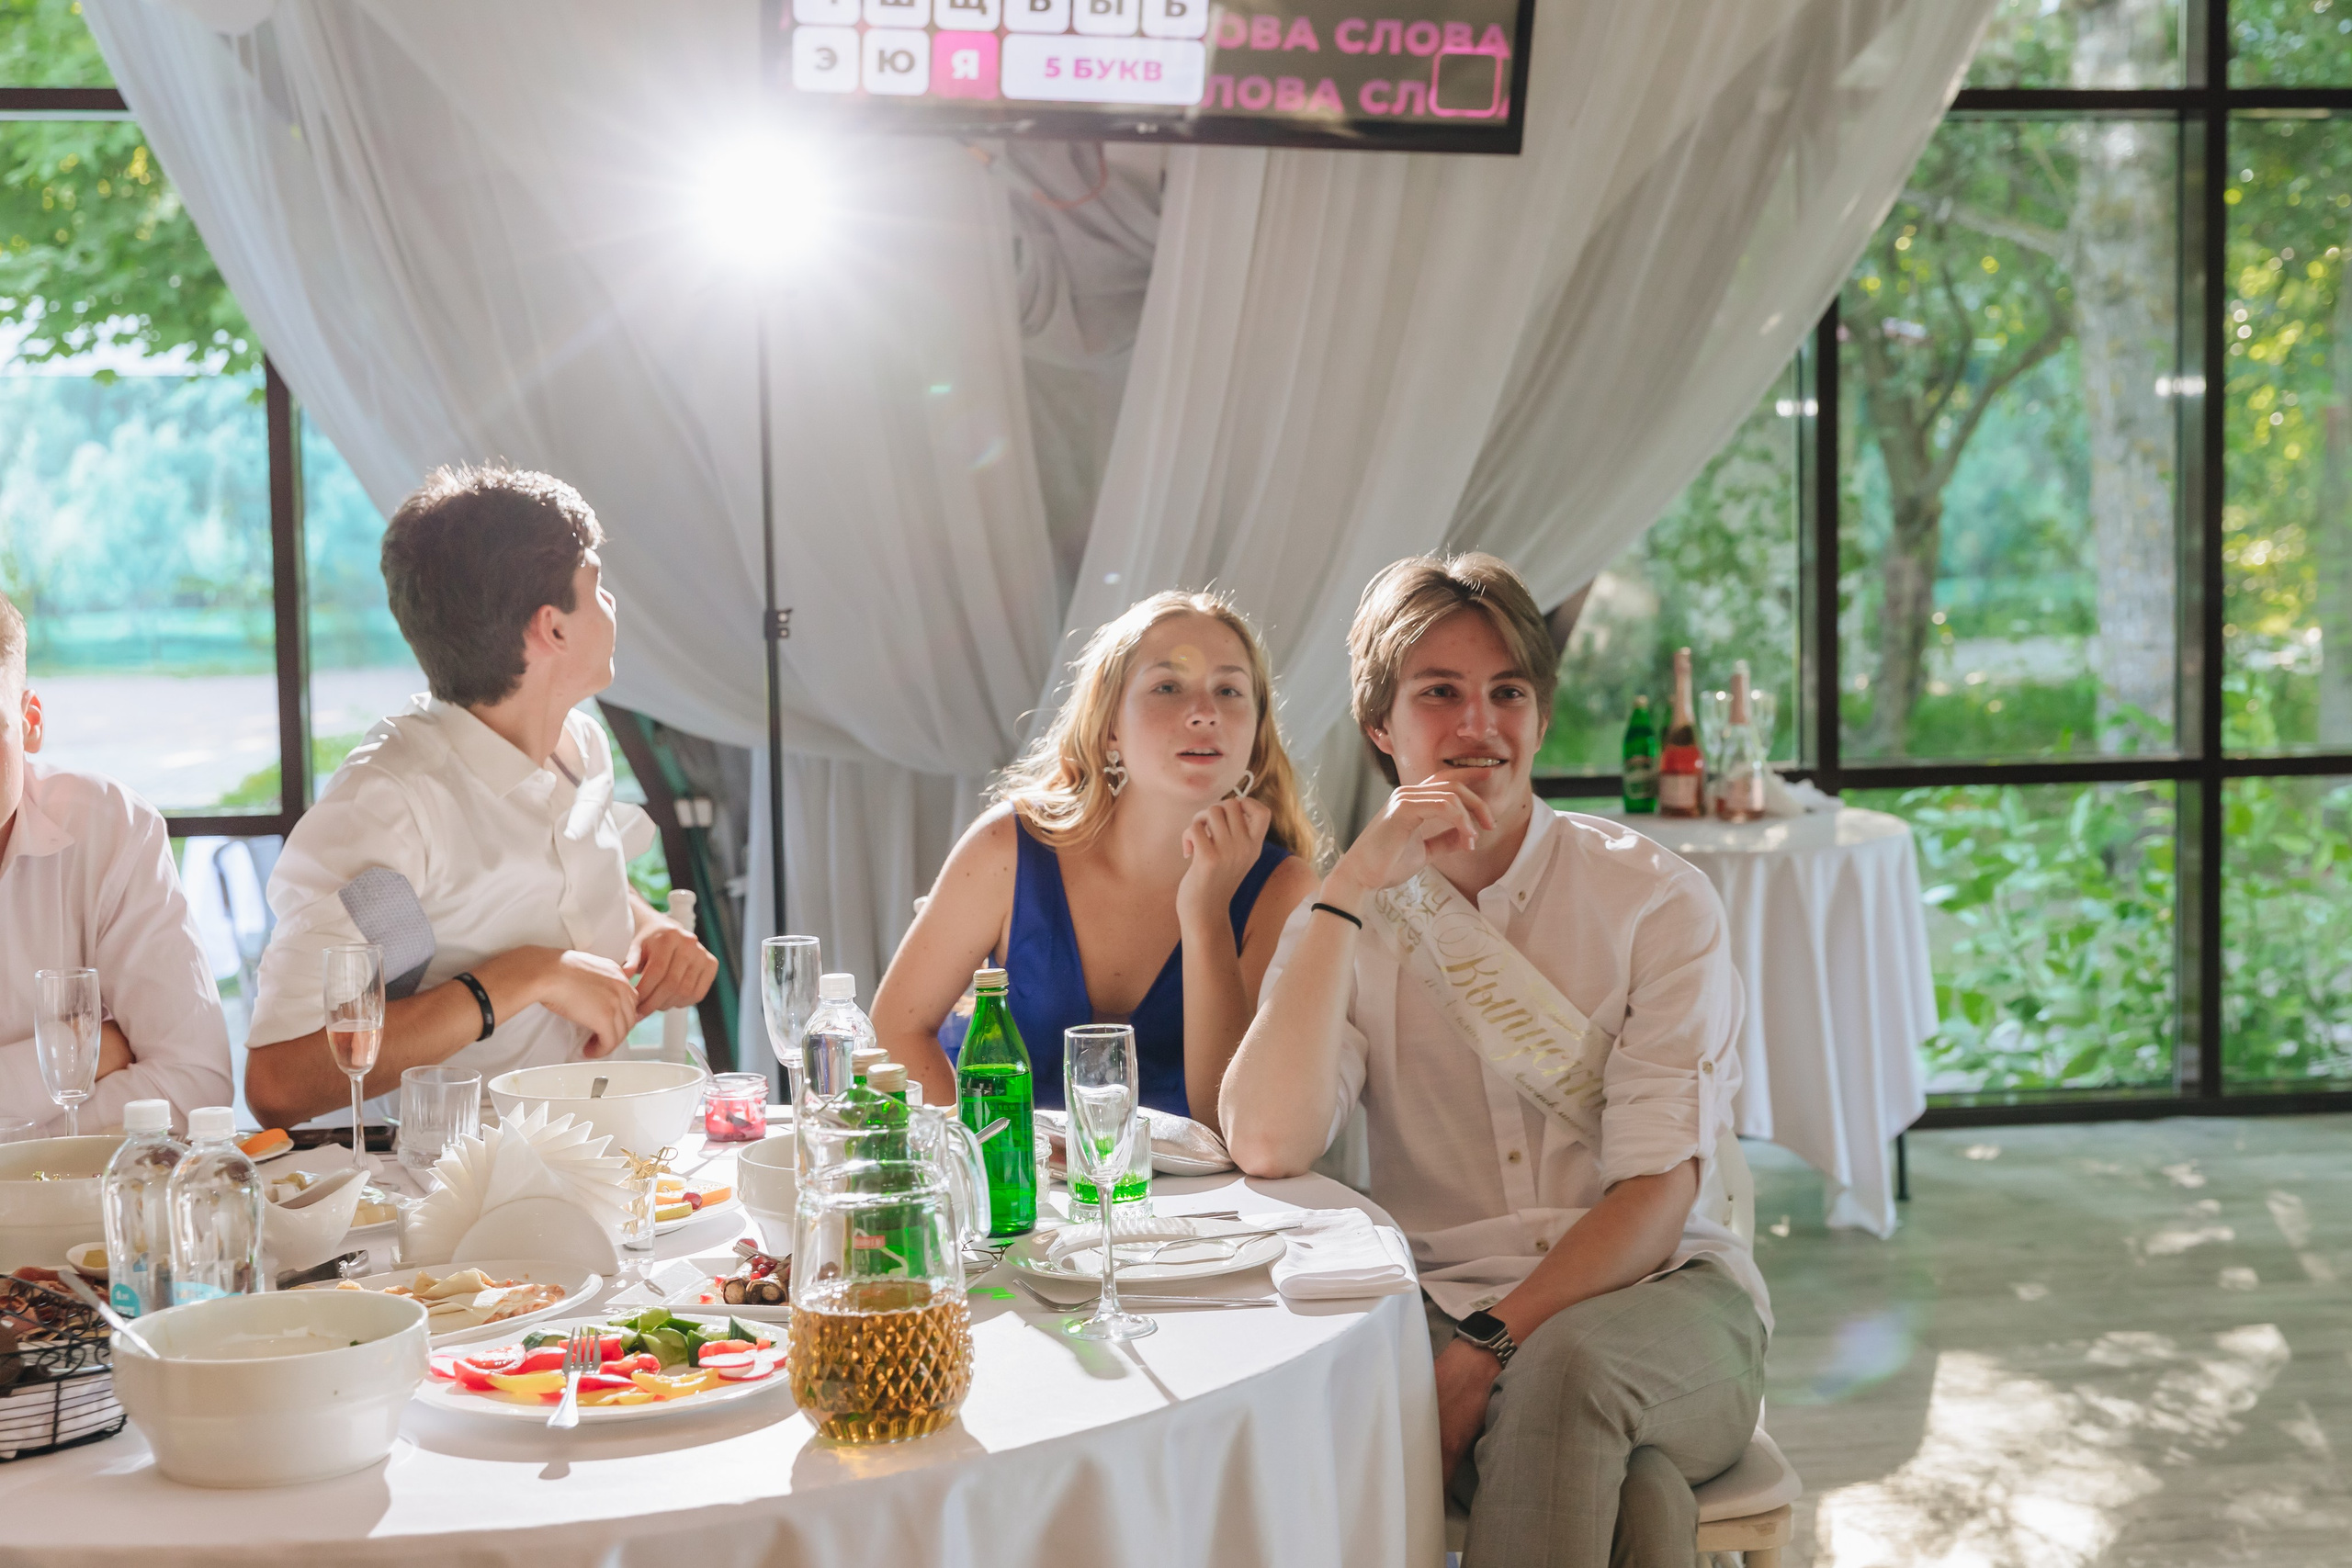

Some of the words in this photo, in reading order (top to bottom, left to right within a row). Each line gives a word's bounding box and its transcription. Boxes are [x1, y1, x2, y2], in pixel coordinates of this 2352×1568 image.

[1215, 13, 1320, 52] ОВА
[1335, 17, 1511, 59] СЛОВА
[814, 47, 838, 71] Э
[878, 50, 915, 73] Ю
[951, 49, 979, 80] Я
[1045, 58, 1061, 77] 5
[1074, 59, 1162, 81] БУКВ
[1201, 74, 1344, 112] ЛОВА
